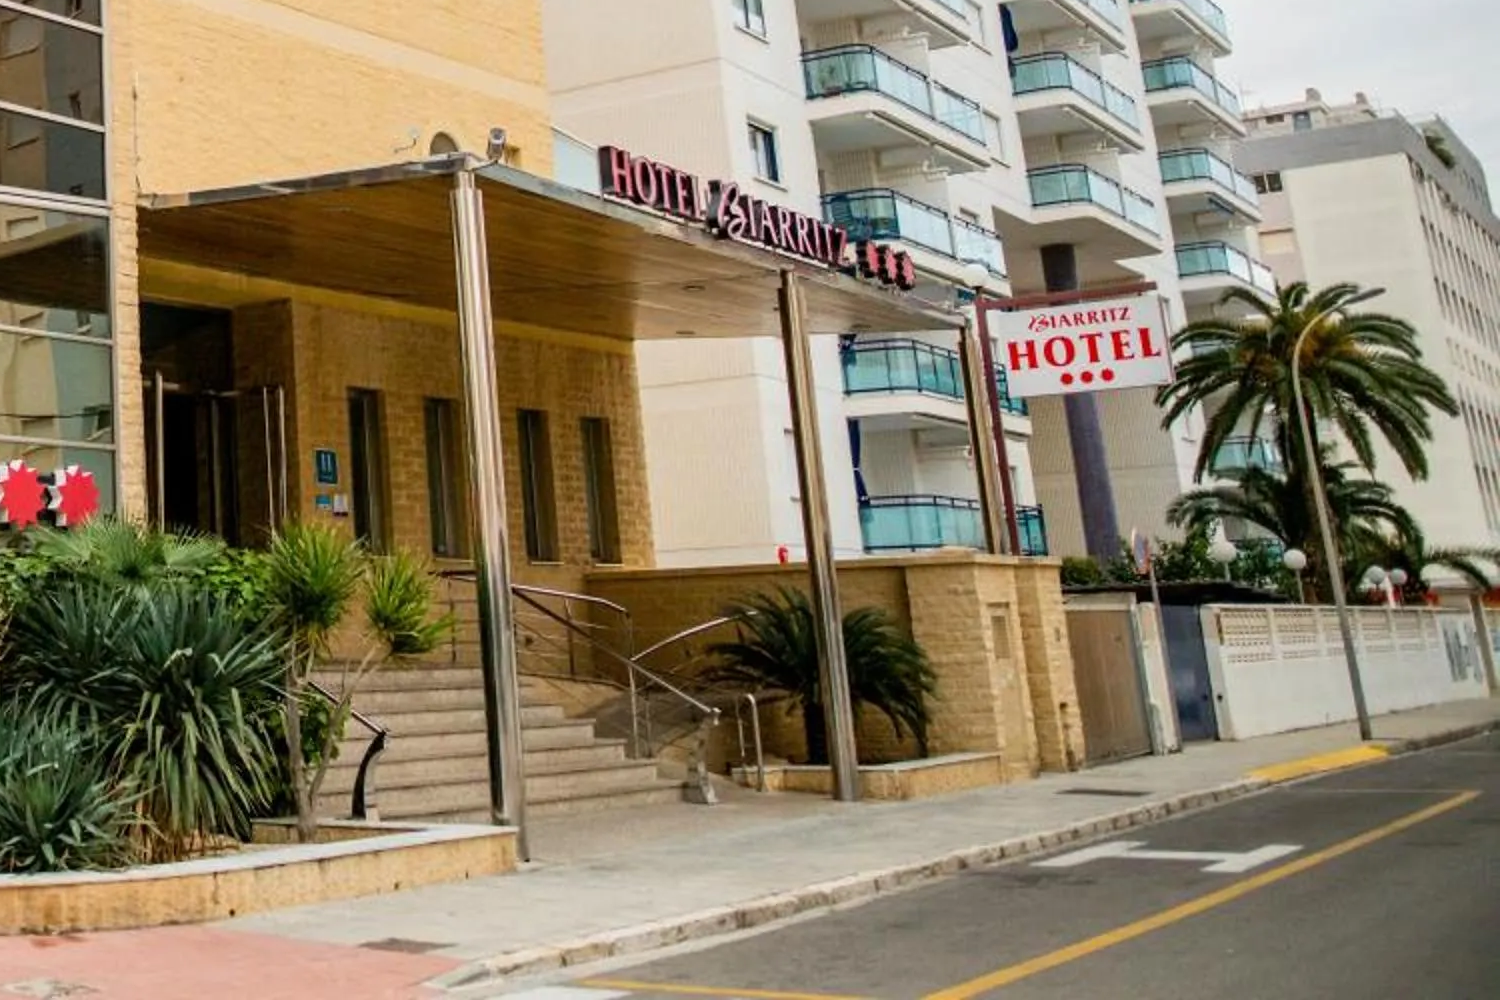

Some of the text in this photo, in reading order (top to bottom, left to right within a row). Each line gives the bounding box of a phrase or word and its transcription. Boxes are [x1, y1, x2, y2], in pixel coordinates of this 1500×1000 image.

[599, 146, 852, 268] HOTEL BIARRITZ
[1028, 306, 1133, 333] BIARRITZ
[1007, 327, 1162, 371] HOTEL
